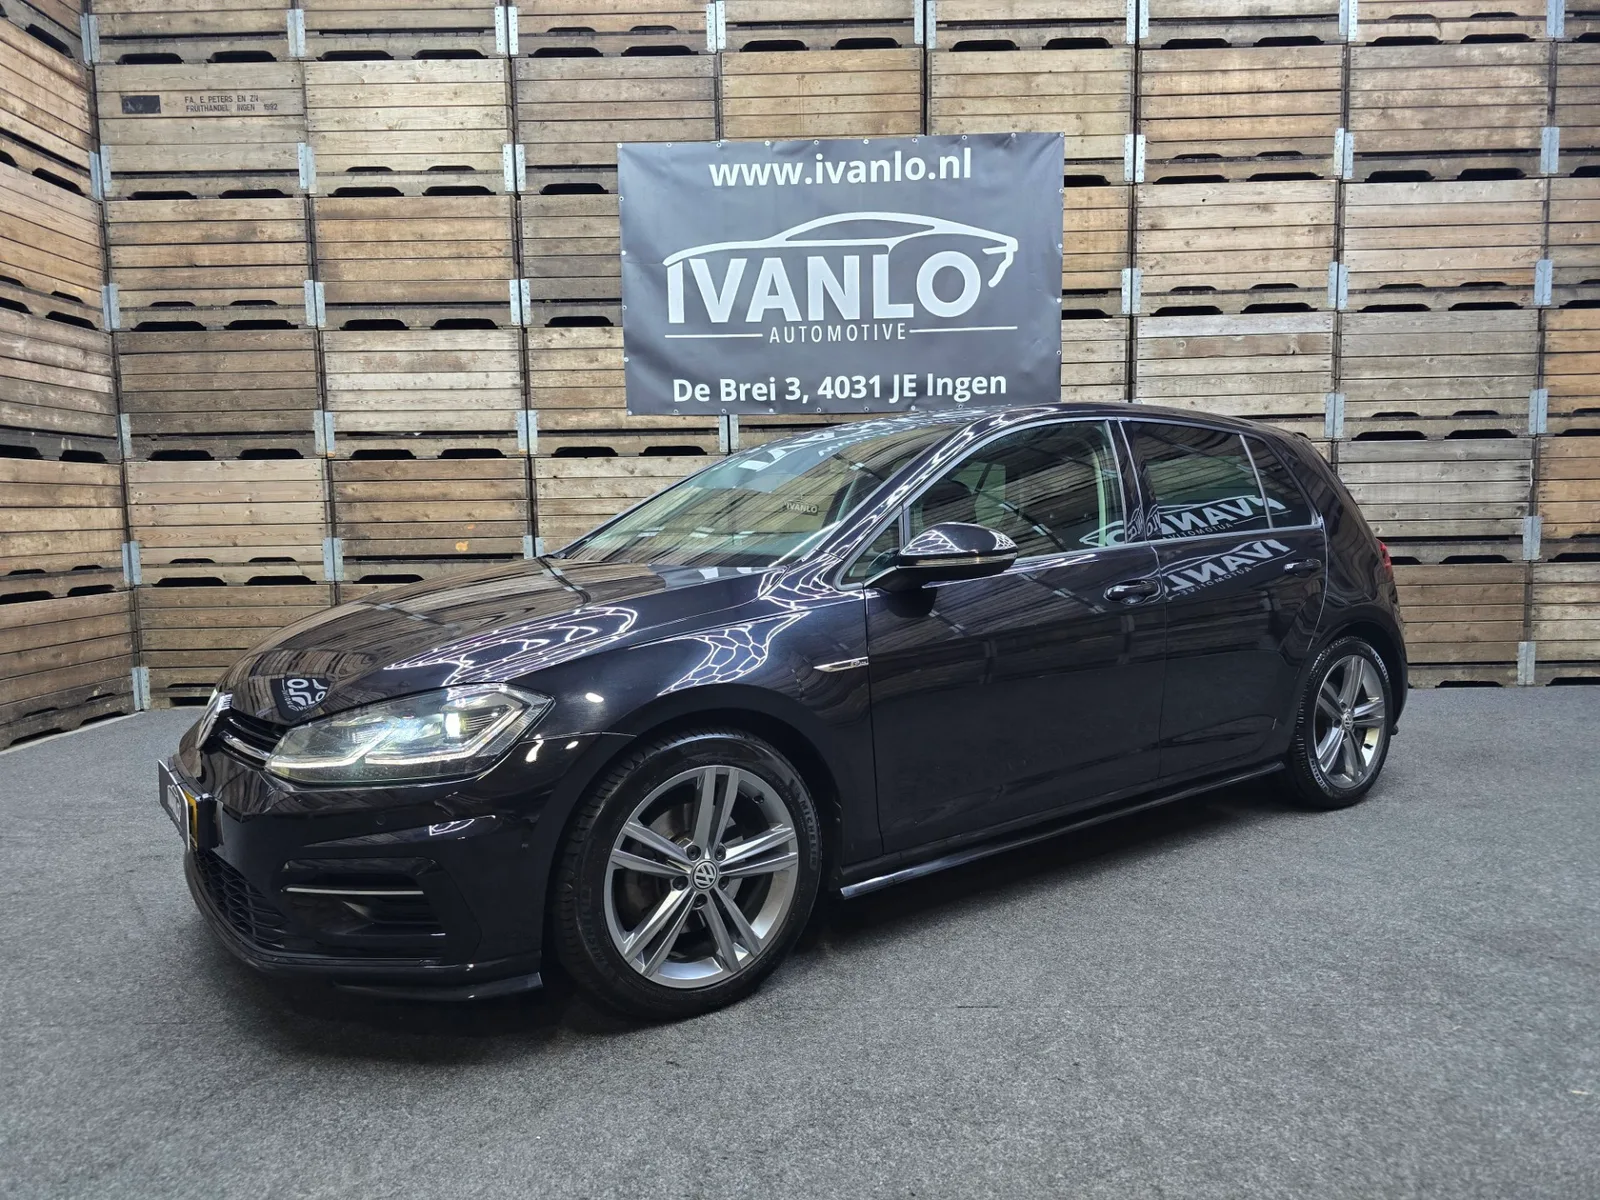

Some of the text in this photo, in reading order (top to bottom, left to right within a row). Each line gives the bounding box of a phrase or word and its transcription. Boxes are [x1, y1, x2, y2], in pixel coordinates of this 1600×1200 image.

[208, 95, 233, 103] PETERS
[237, 95, 247, 103] EN
[708, 147, 972, 187] www.ivanlo.nl
[667, 250, 982, 324] IVANLO
[769, 323, 907, 344] AUTOMOTIVE
[673, 373, 1007, 404] De Brei 3, 4031 JE Ingen
